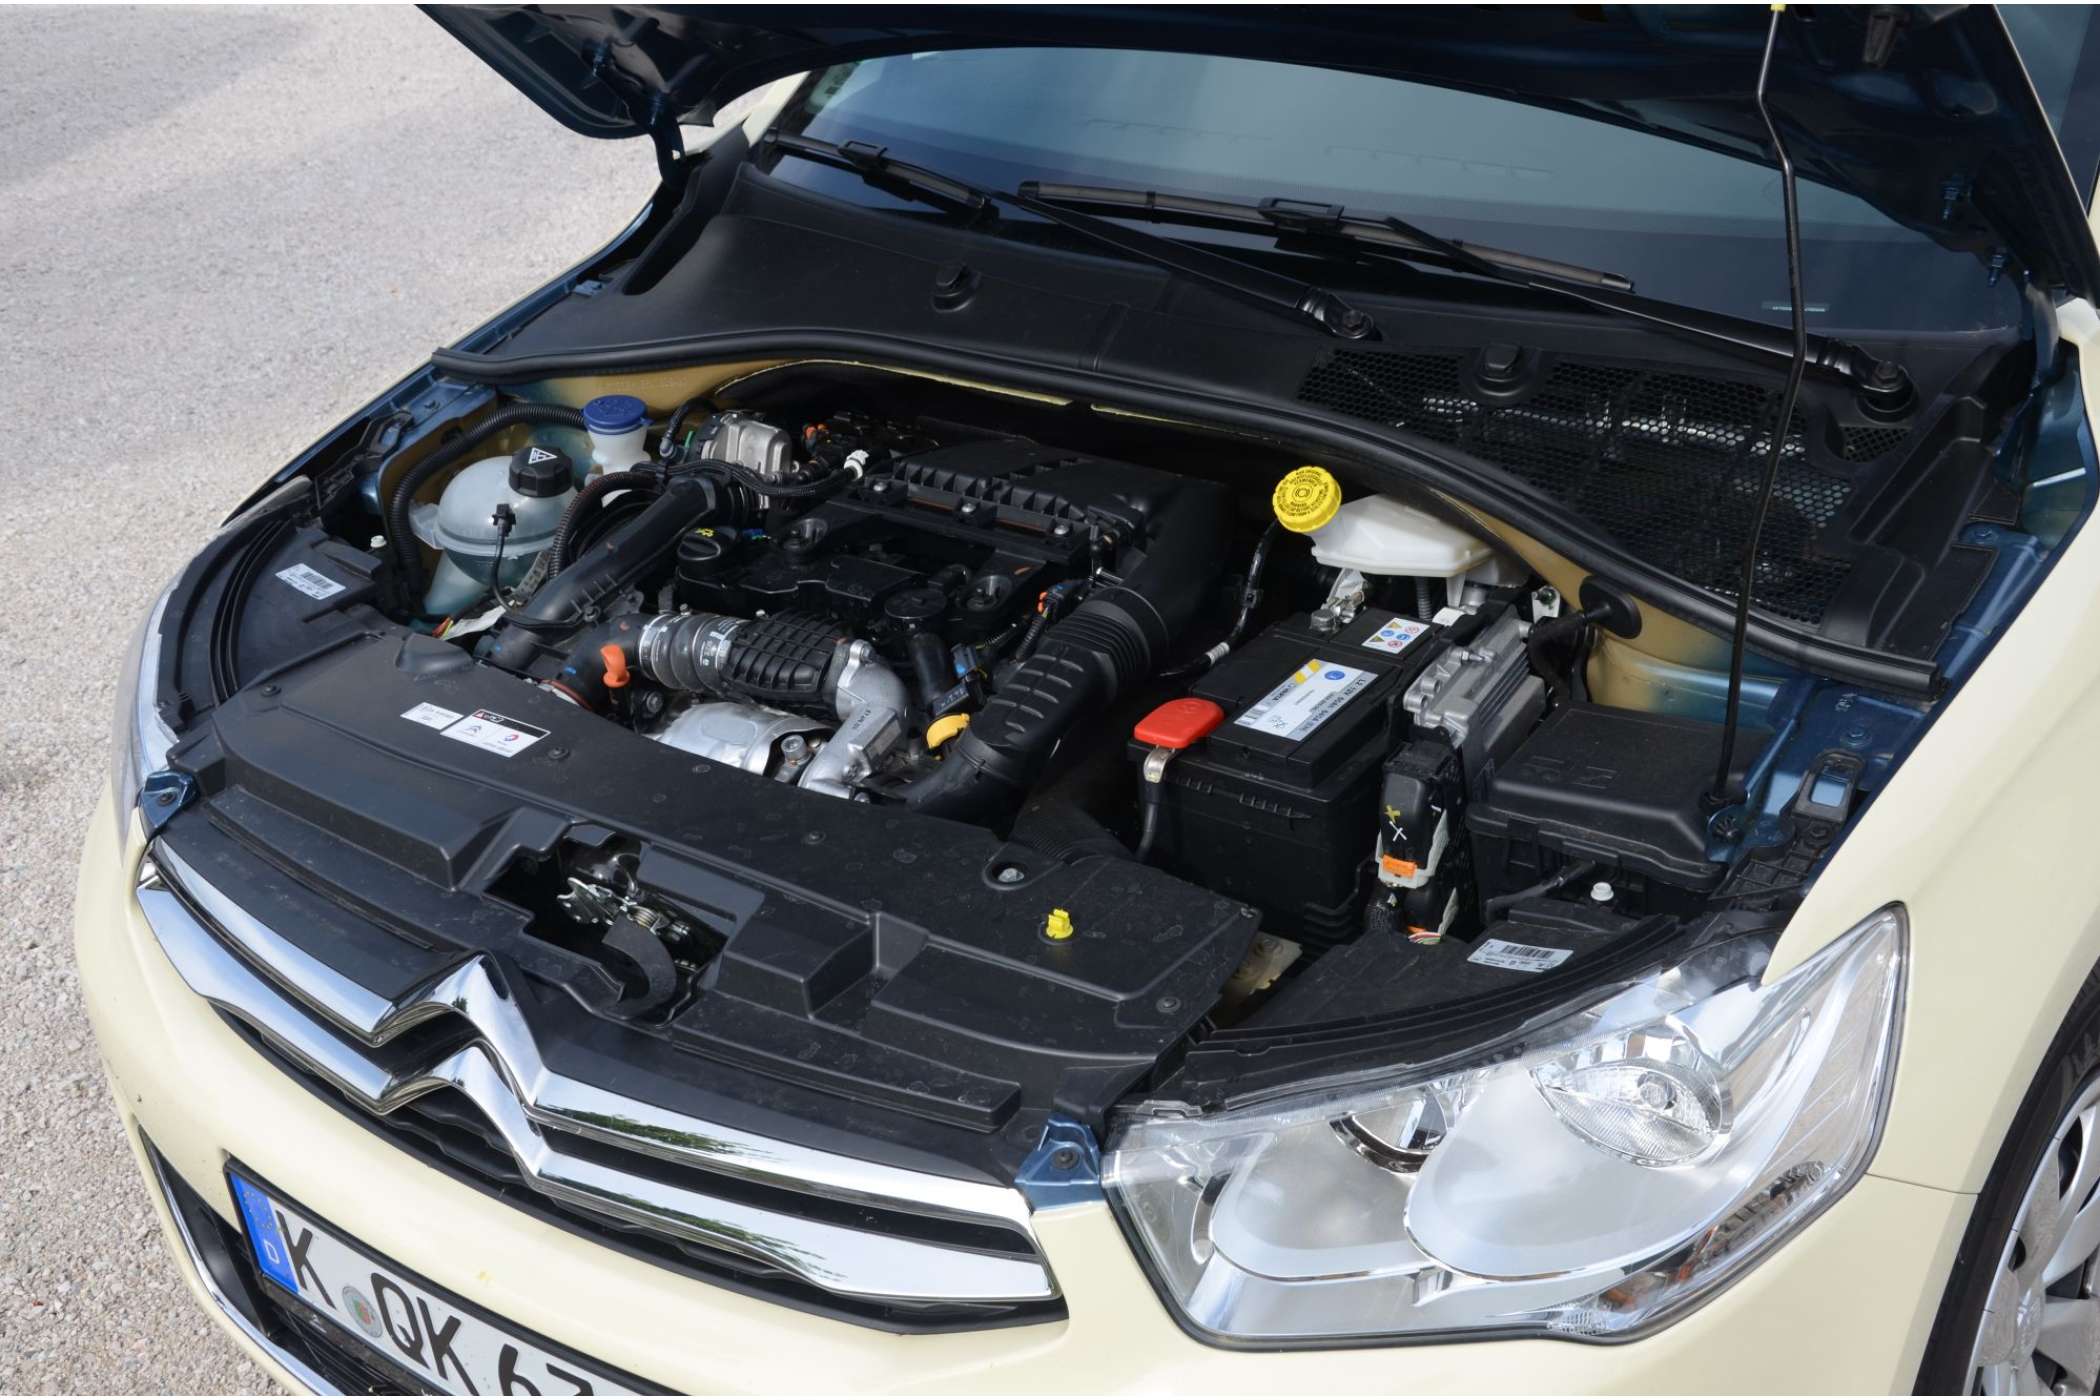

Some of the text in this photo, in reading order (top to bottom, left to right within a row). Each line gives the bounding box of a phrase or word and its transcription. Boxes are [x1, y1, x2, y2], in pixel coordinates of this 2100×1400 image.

[264, 1240, 281, 1265] D
[276, 1209, 336, 1309] K
[370, 1272, 478, 1395] QK
